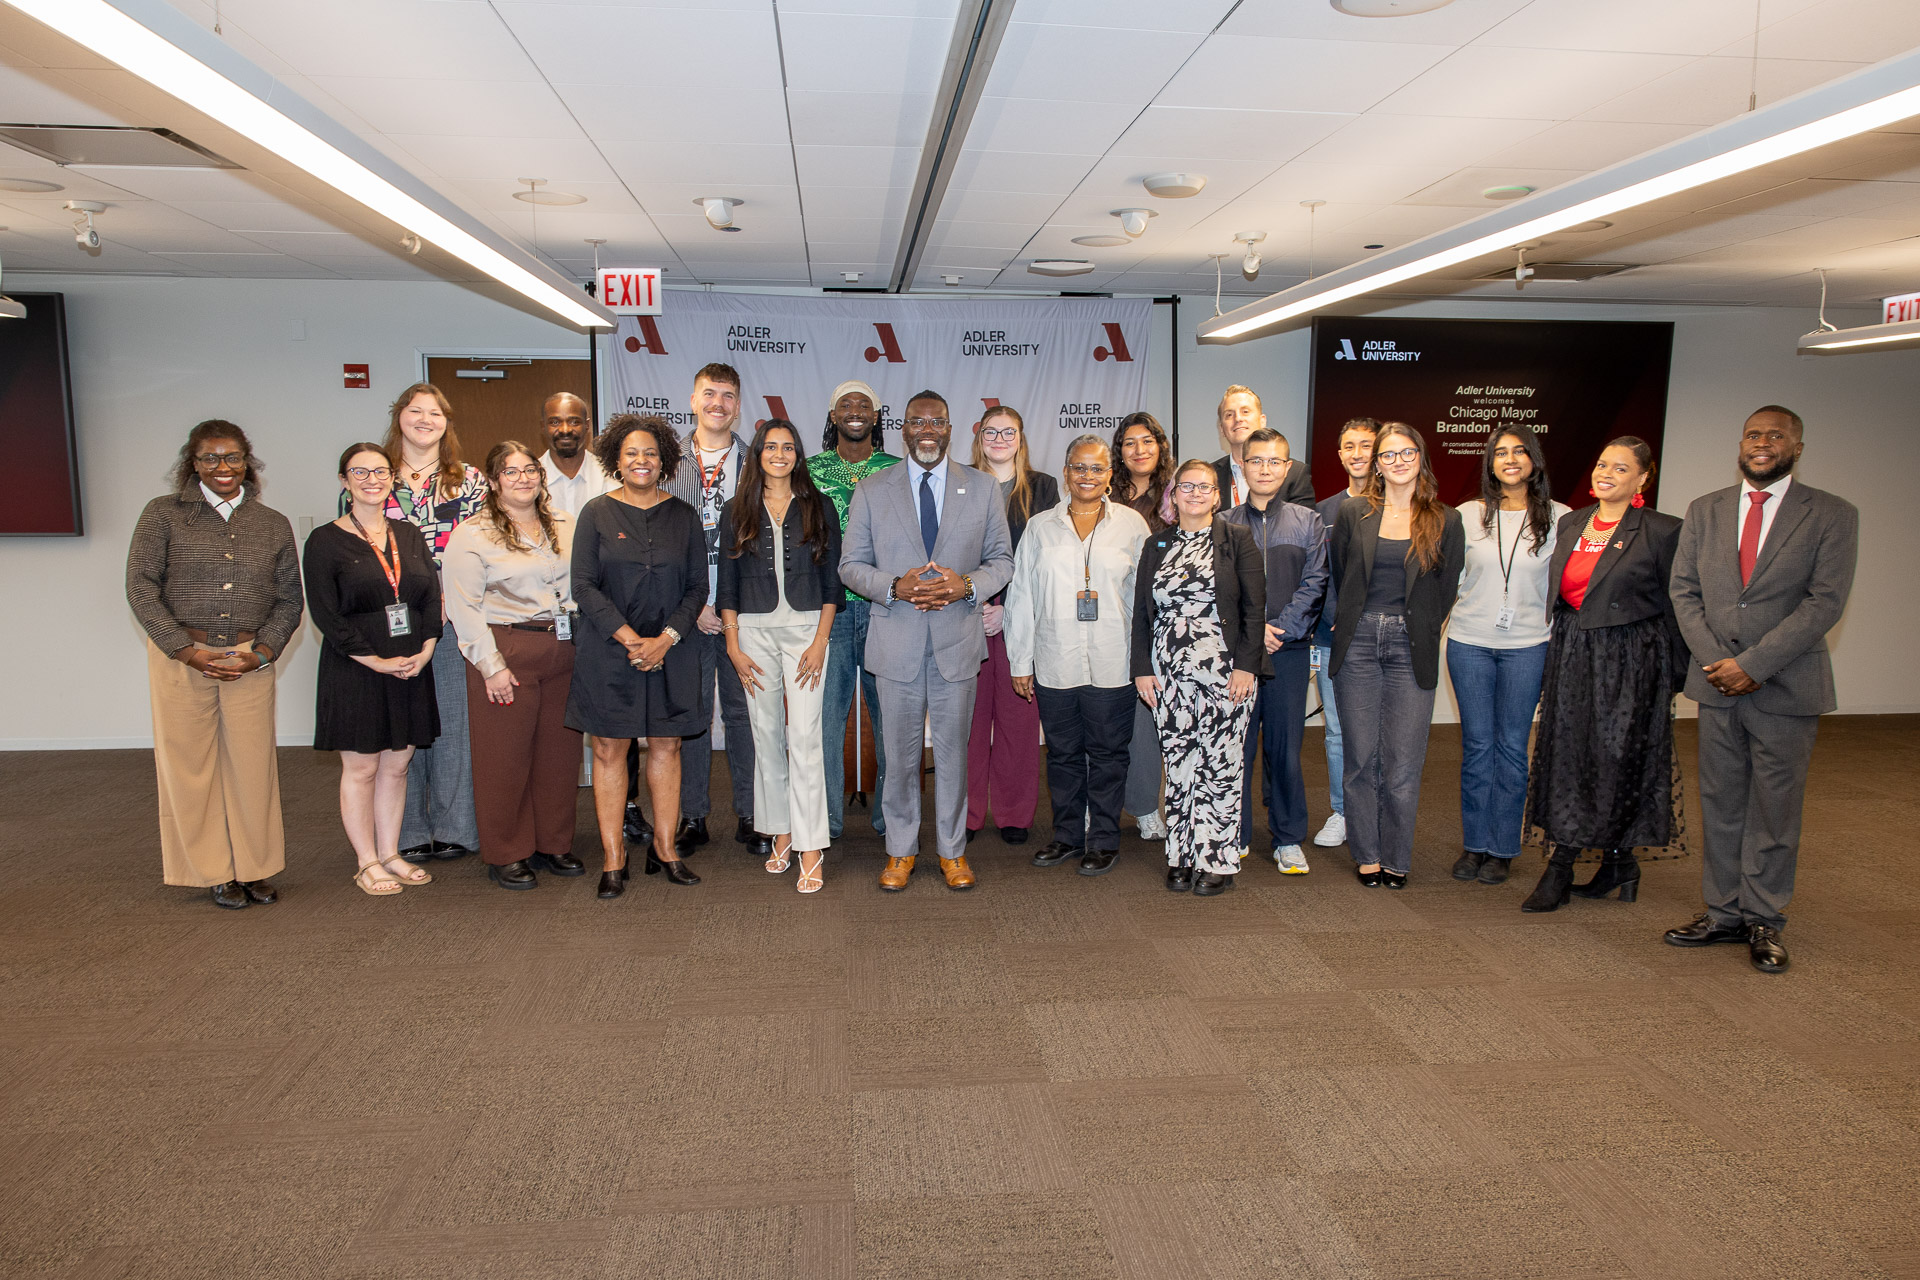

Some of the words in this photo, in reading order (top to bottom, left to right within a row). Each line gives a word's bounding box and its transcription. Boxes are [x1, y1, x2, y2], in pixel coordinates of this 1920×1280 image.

[604, 274, 655, 306] EXIT
[727, 325, 771, 339] ADLER
[962, 330, 1006, 343] ADLER
[727, 339, 806, 354] UNIVERSITY
[962, 343, 1040, 357] UNIVERSITY
[1362, 340, 1396, 351] ADLER
[1361, 351, 1421, 362] UNIVERSITY
[1455, 385, 1484, 395] Adler
[1485, 385, 1536, 398] University
[626, 396, 670, 410] ADLER
[1473, 397, 1515, 405] welcomes
[1059, 403, 1101, 415] ADLER
[1449, 405, 1499, 421] Chicago
[1501, 406, 1539, 421] Mayor
[1059, 416, 1125, 429] UNIVERSIT
[1436, 421, 1491, 433] Brandon
